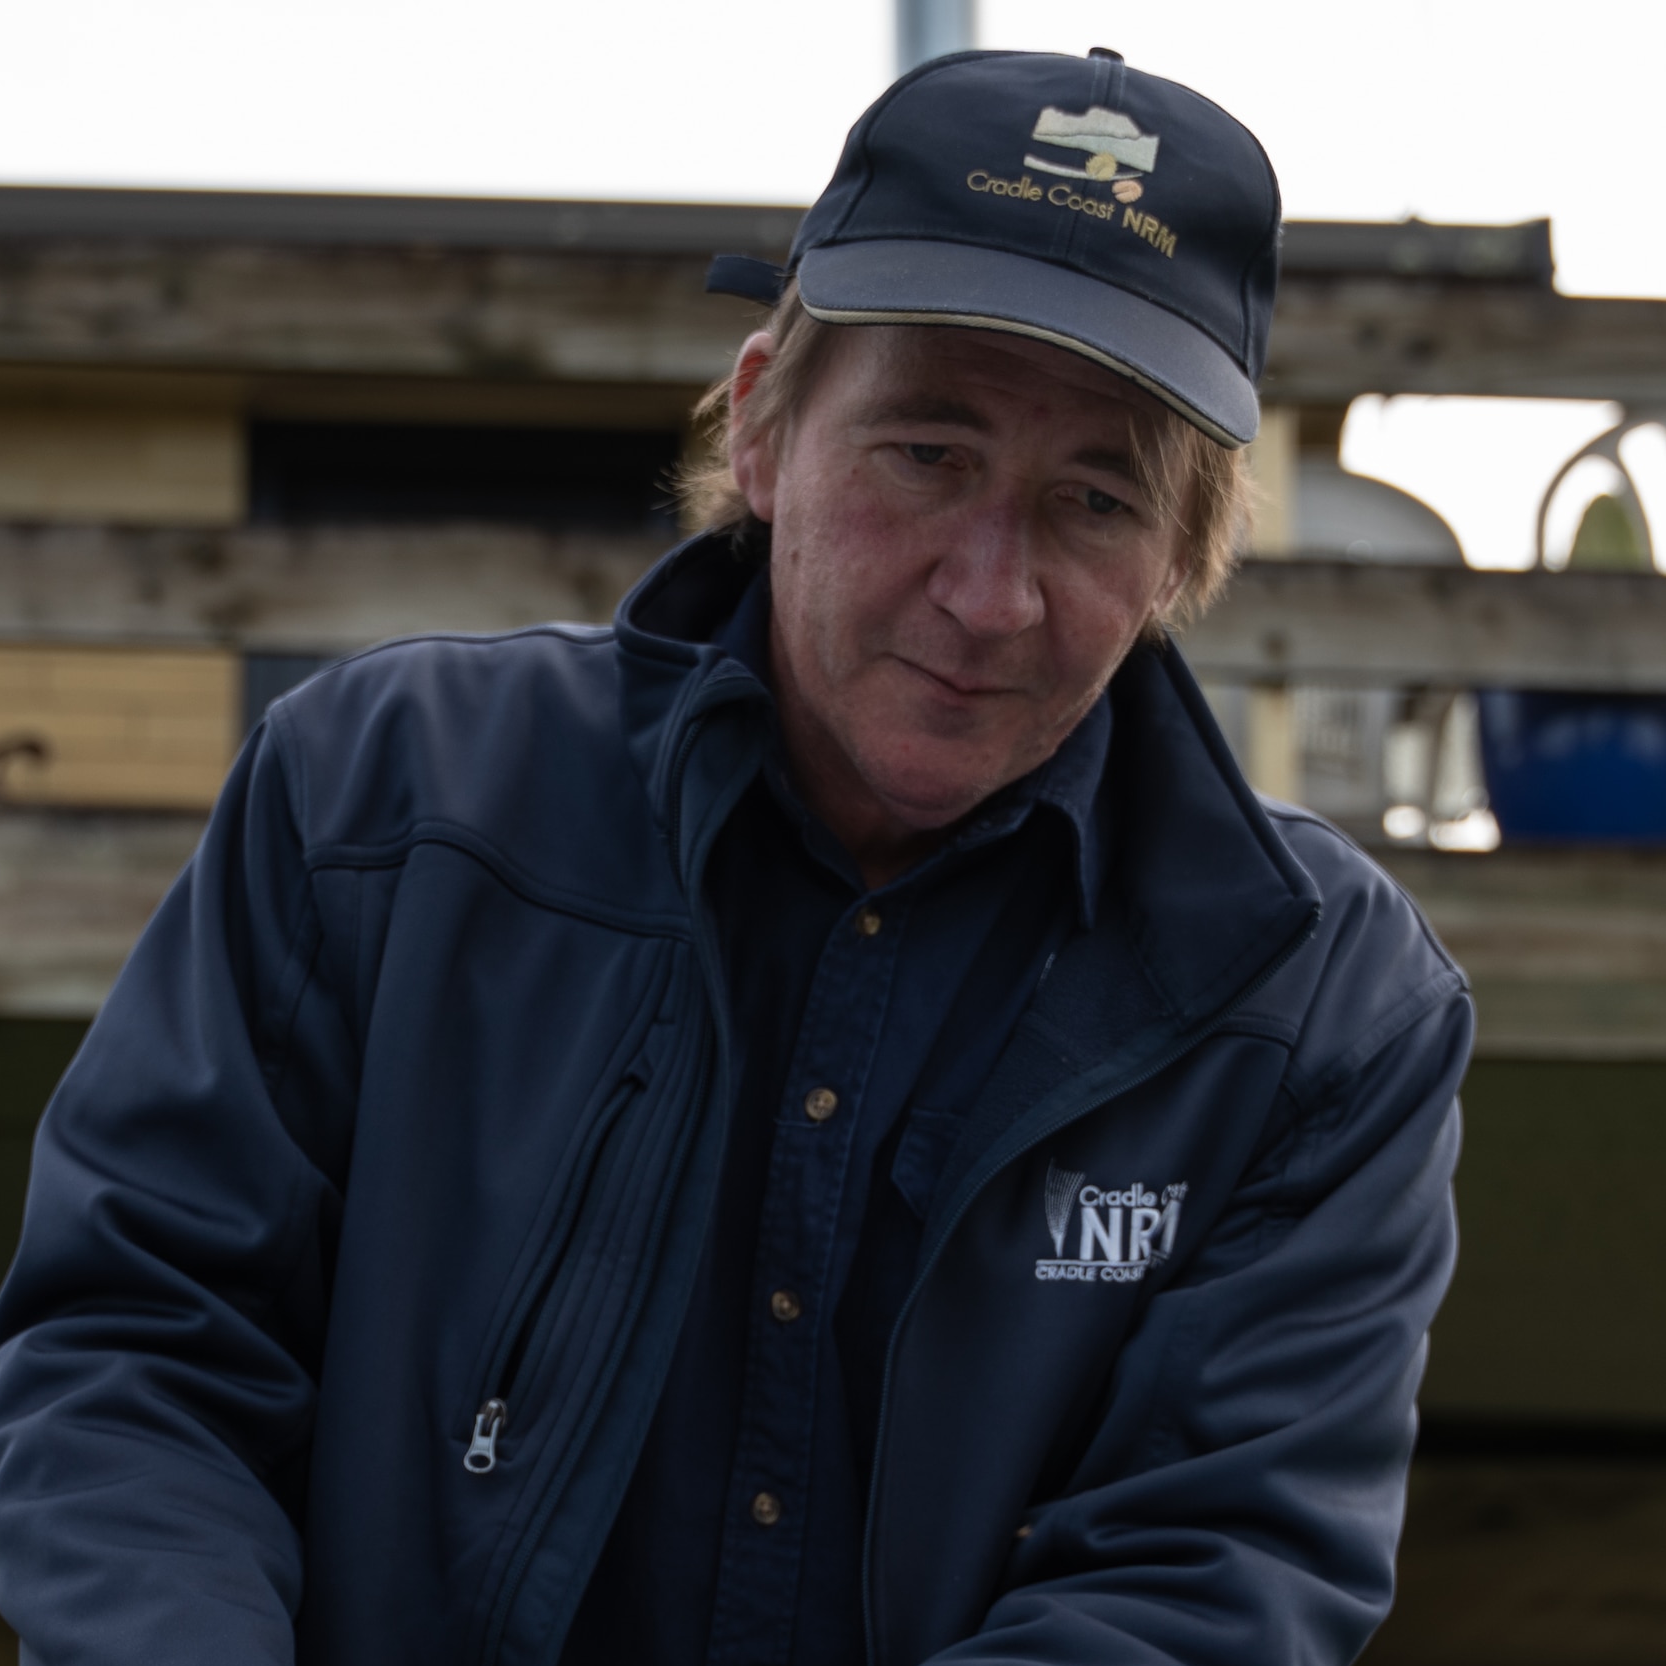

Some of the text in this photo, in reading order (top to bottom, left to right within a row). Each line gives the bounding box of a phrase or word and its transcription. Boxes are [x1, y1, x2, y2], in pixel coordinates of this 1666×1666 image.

[967, 170, 1178, 259] Cradle Coast NRM
[1079, 1181, 1158, 1207] Cradle
[1035, 1264, 1096, 1281] CRADLE
